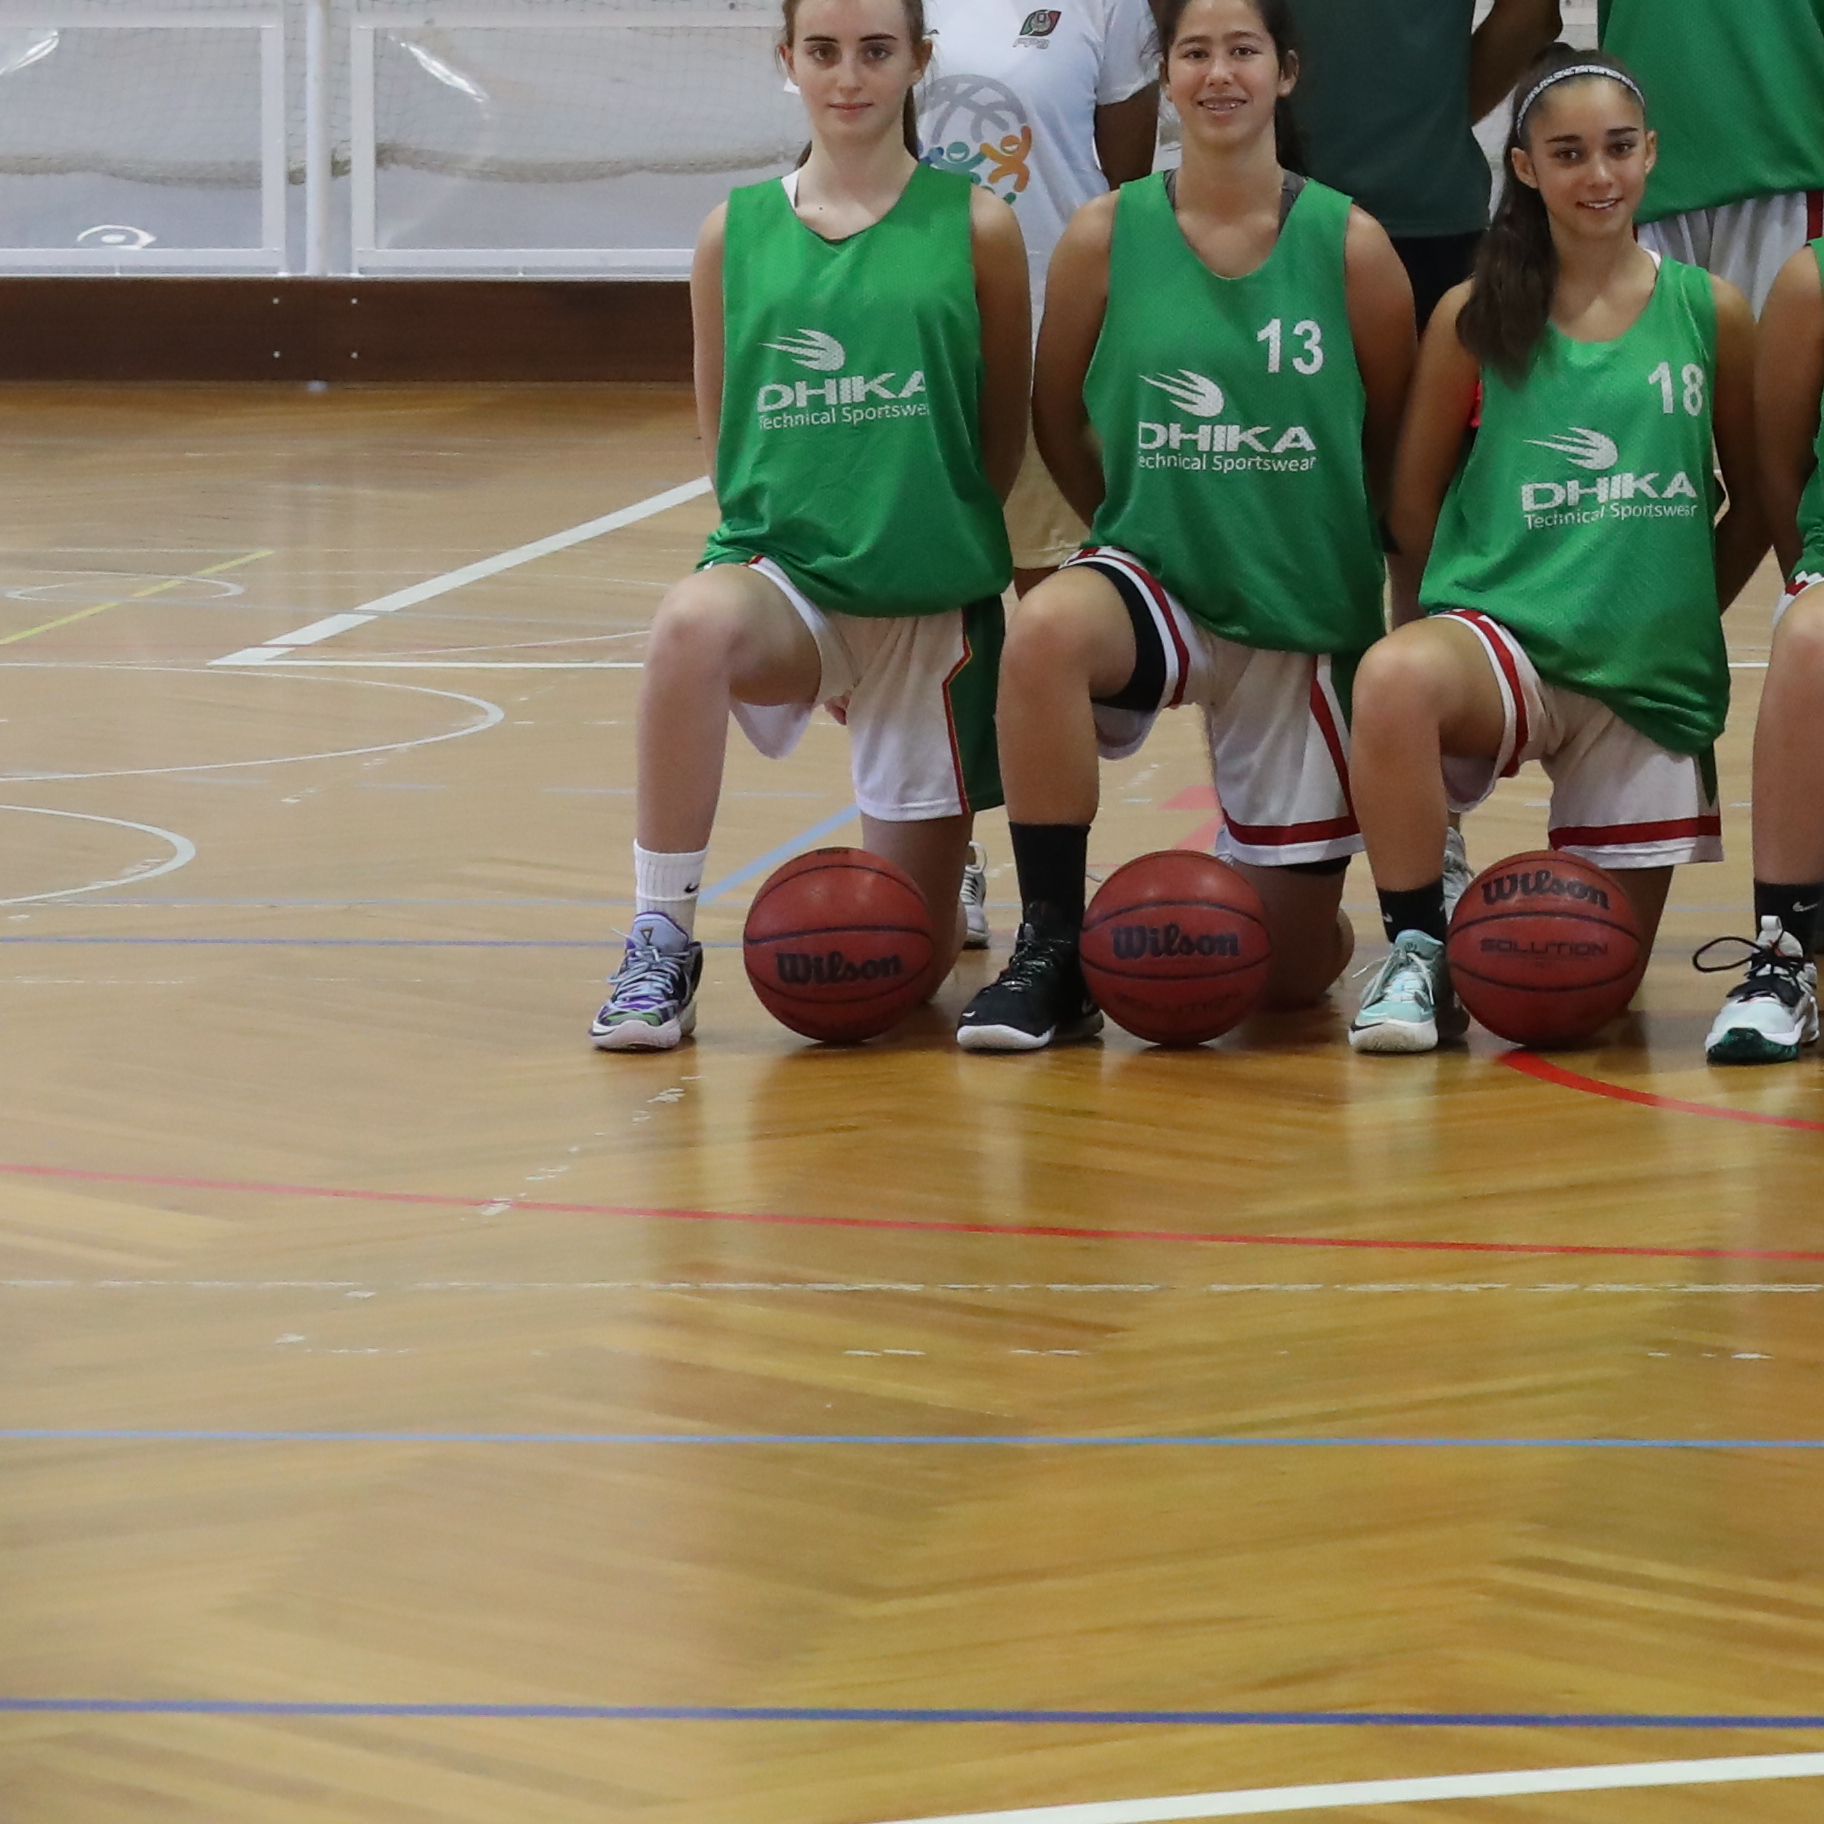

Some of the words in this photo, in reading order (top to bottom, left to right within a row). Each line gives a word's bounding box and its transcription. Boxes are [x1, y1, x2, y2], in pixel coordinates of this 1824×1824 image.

[1257, 318, 1324, 375] 13
[757, 370, 927, 412] DHIKA
[1647, 361, 1704, 416] 18
[1138, 421, 1317, 453] DHIKA
[1139, 451, 1207, 470] echnical
[1212, 454, 1317, 473] Sportswear
[1521, 471, 1698, 511] DHIKA
[1609, 502, 1698, 520] Sportswear
[1481, 869, 1611, 911] Wilson
[1111, 923, 1240, 960] Wilson
[1481, 938, 1608, 957] SOLUTION
[776, 950, 904, 985] Wilson
